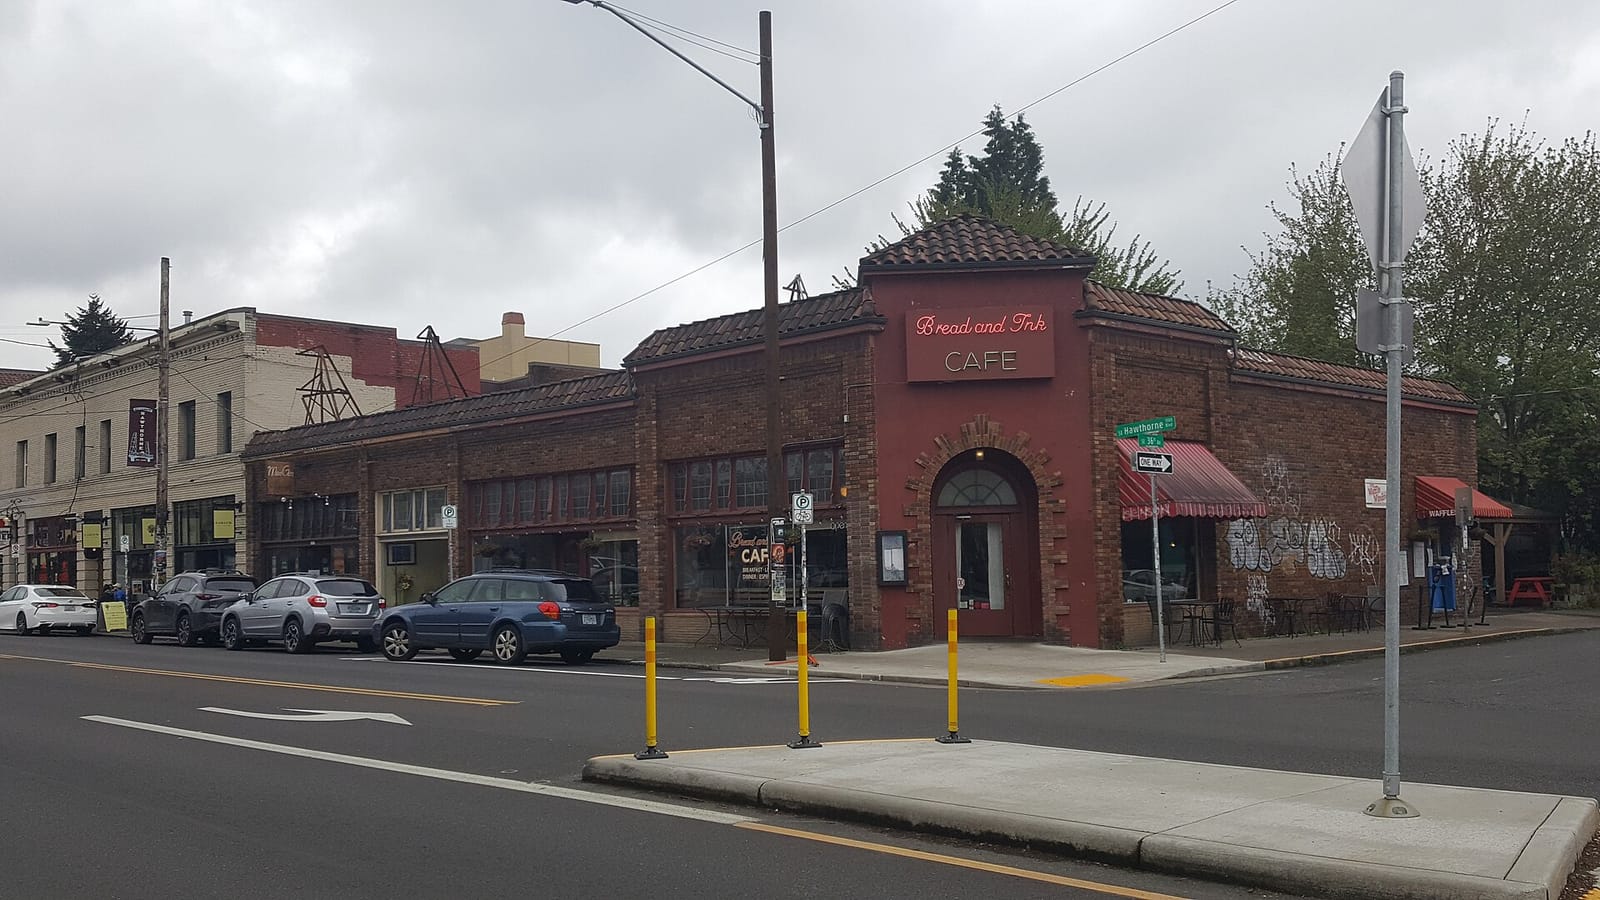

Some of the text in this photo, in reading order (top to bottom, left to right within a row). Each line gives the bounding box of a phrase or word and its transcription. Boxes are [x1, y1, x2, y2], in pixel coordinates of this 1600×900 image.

[916, 312, 1048, 336] Bread and Ink
[945, 350, 1017, 372] CAFE
[1124, 421, 1164, 435] Hawthorne
[1140, 457, 1162, 467] ONE WAY
[799, 498, 807, 506] P
[741, 548, 769, 563] CAF
